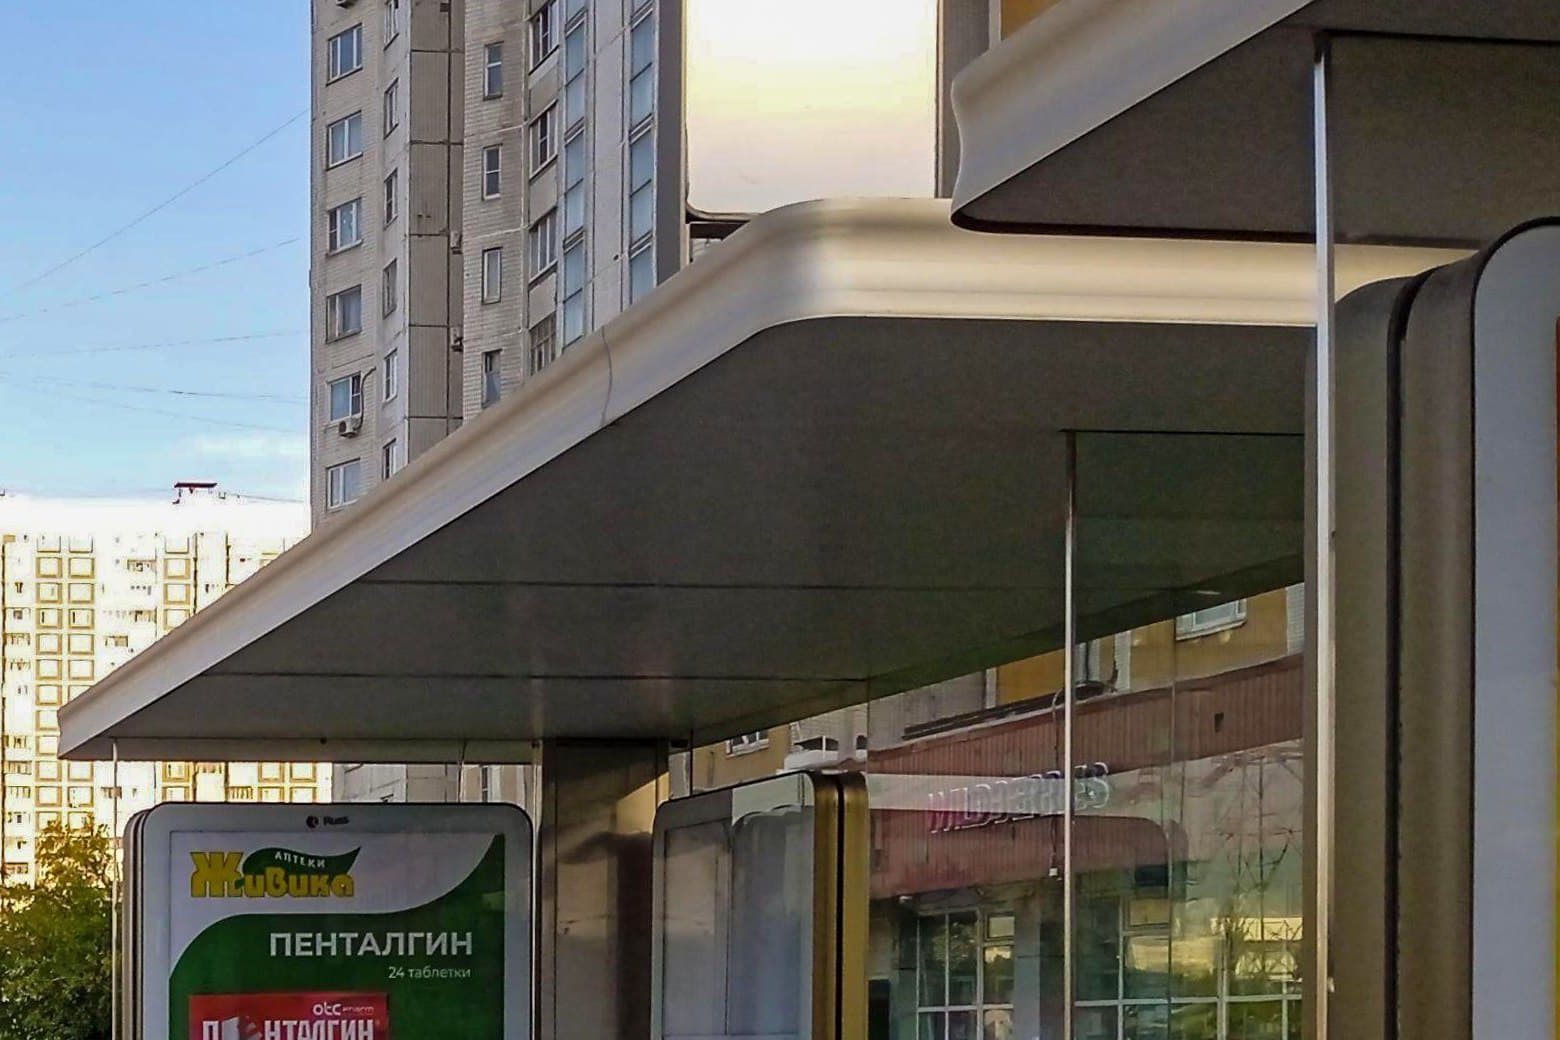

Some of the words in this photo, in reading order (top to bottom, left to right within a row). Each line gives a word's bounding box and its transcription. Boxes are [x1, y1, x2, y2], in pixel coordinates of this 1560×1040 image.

[274, 851, 326, 868] АПТЕКИ
[270, 932, 472, 957] ПЕНТАЛГИН
[389, 966, 405, 979] 24
[408, 966, 471, 979] таблетки
